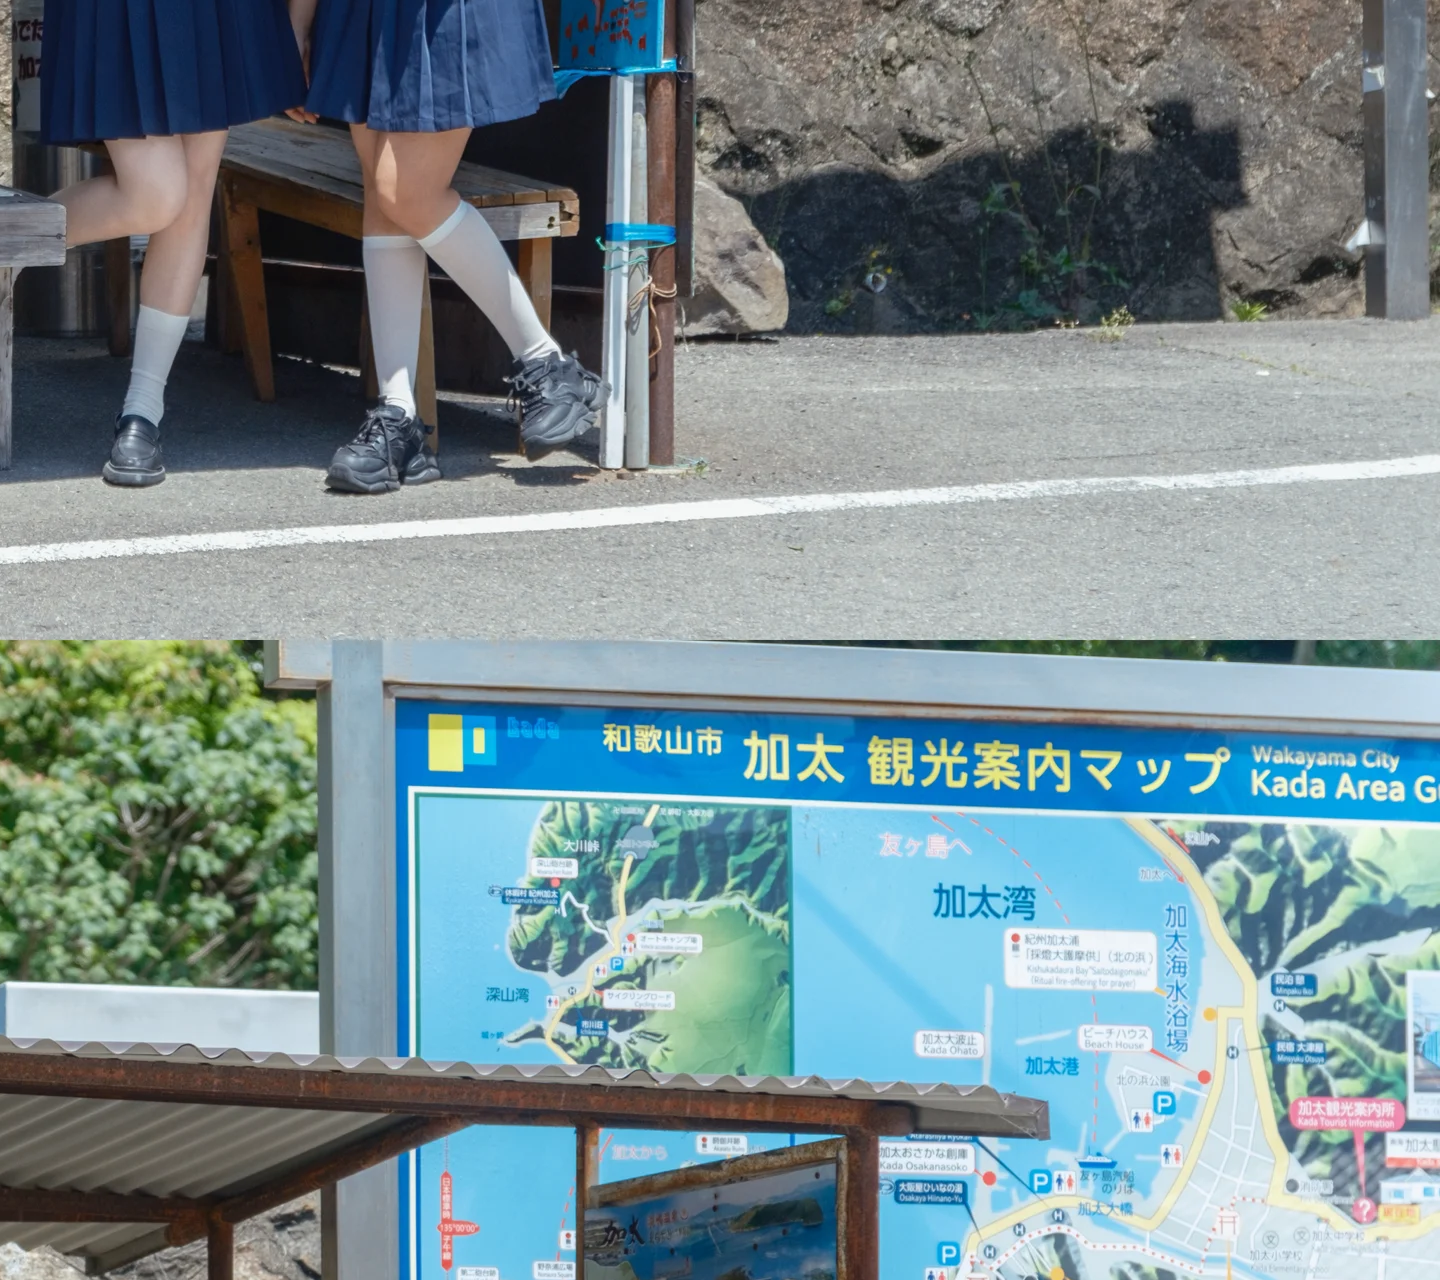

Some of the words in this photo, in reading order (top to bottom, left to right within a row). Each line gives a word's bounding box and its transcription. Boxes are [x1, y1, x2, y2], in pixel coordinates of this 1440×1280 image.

[602, 722, 723, 756] 和歌山市
[743, 730, 846, 784] 加太
[867, 735, 1231, 794] 観光案内マップ
[1251, 745, 1360, 768] Wakayama
[1362, 749, 1400, 773] City
[1251, 768, 1326, 799] Kada
[1335, 772, 1406, 803] Area
[879, 832, 973, 859] 友ヶ島へ
[933, 882, 1036, 921] 加太湾
[1164, 904, 1189, 1053] 加太海水浴場
[1083, 1027, 1149, 1040] ビーチハウス
[1025, 1057, 1080, 1076] 加太港
[1116, 1075, 1171, 1087] 北の浜公園
[1298, 1100, 1396, 1118] 加太観光案内所
[879, 1146, 969, 1160] 加太おさかな創庫
[1078, 1201, 1134, 1217] 加太大橋
